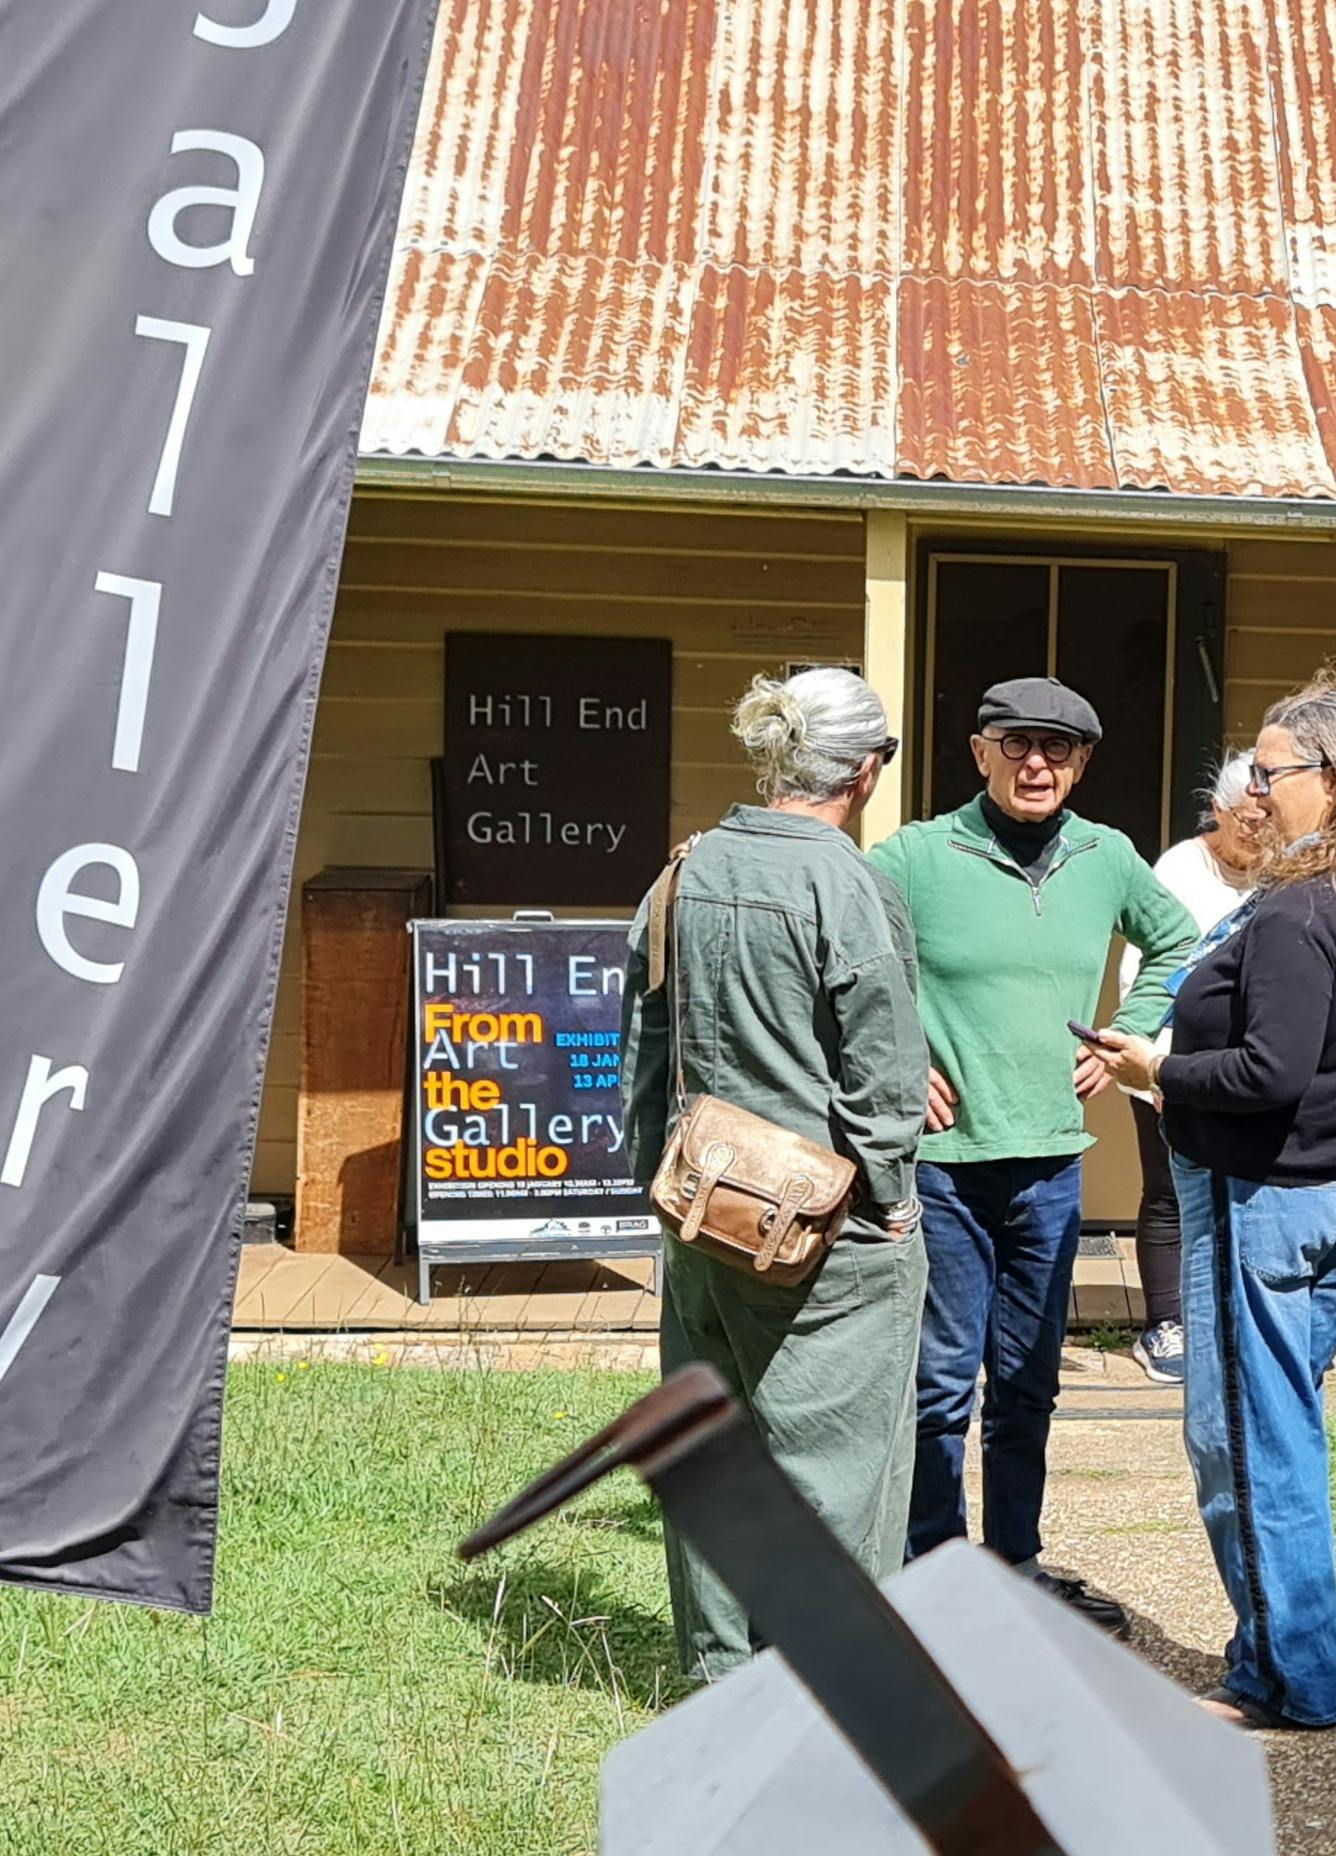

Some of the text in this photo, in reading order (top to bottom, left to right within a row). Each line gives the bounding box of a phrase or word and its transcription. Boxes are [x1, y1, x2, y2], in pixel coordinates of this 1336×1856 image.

[0, 0, 297, 1379] aller
[469, 694, 647, 730] Hill End
[467, 753, 538, 786] Art
[467, 811, 626, 853] Gallery
[425, 952, 624, 996] Hill En
[424, 1003, 543, 1043] From
[556, 1032, 621, 1047] EXHIBIT
[423, 1029, 519, 1070] Art
[423, 1071, 501, 1111] the
[573, 1073, 621, 1089] 13 AP
[424, 1104, 624, 1153] Gallery
[425, 1138, 568, 1179] studio
